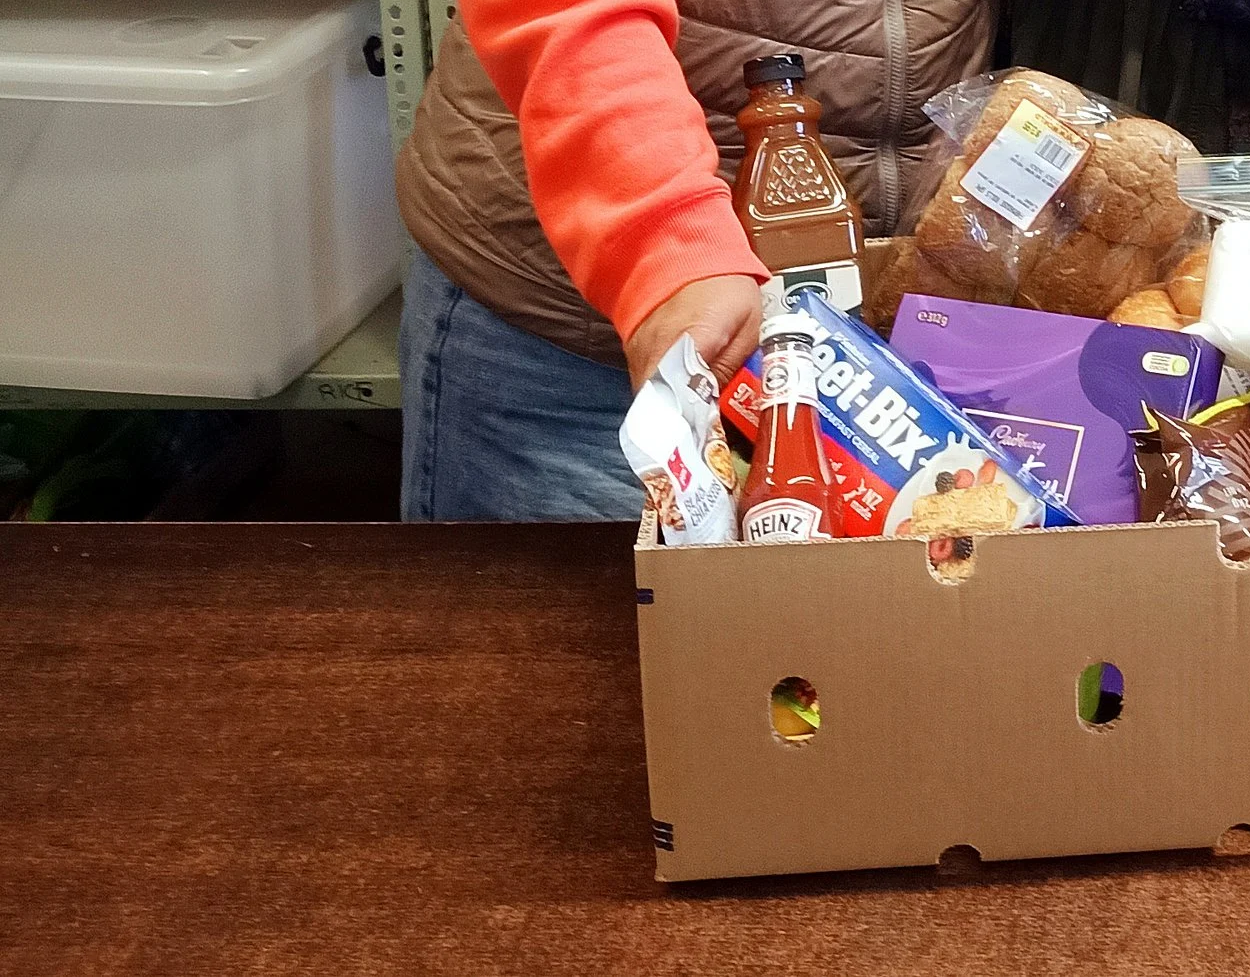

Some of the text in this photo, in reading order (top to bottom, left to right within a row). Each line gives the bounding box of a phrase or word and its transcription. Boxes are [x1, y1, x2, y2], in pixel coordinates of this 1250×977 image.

[990, 425, 1046, 456] Cadbury
[861, 488, 883, 511] NZ
[750, 513, 803, 540] HEINZ
